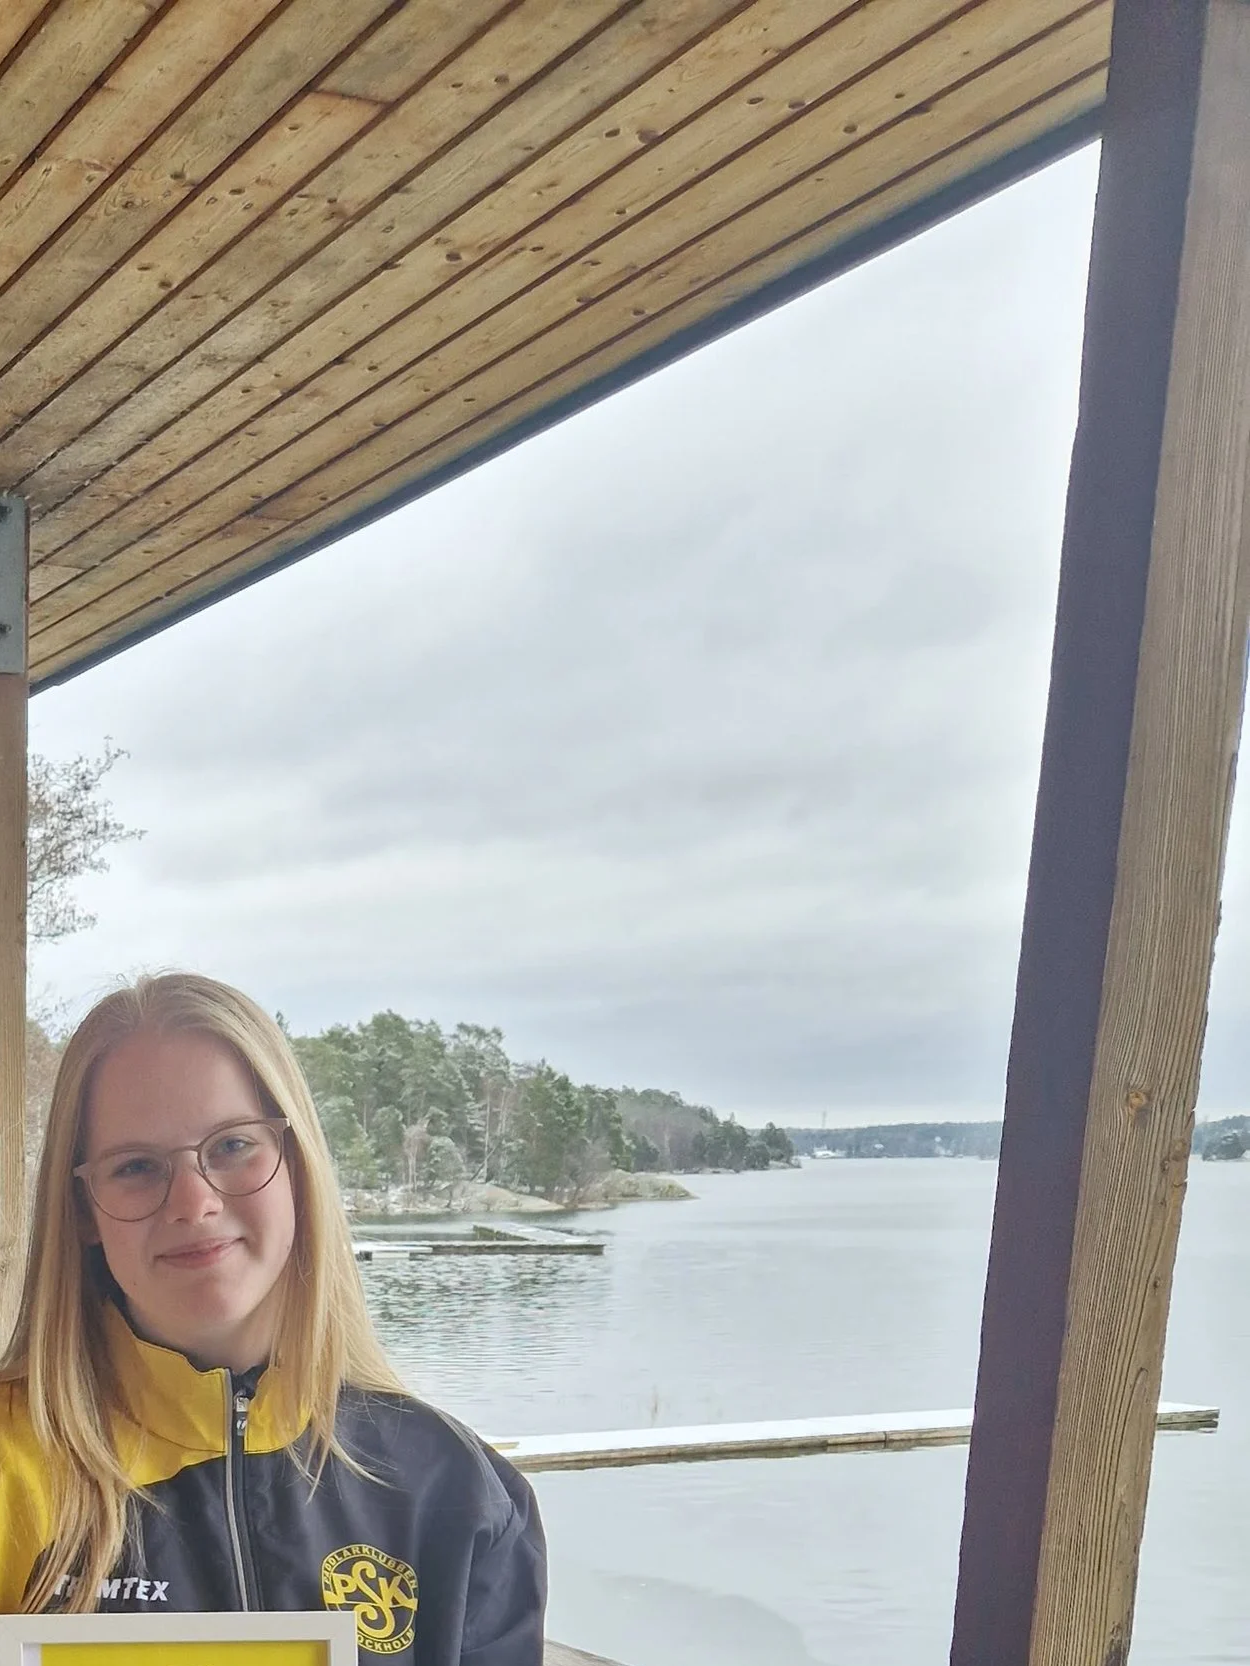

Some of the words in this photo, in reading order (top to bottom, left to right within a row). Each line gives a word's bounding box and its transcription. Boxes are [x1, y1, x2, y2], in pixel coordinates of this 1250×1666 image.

[54, 1574, 170, 1601] TMTEX
[332, 1560, 409, 1639] PSK
[357, 1628, 415, 1652] OCKHOLM
